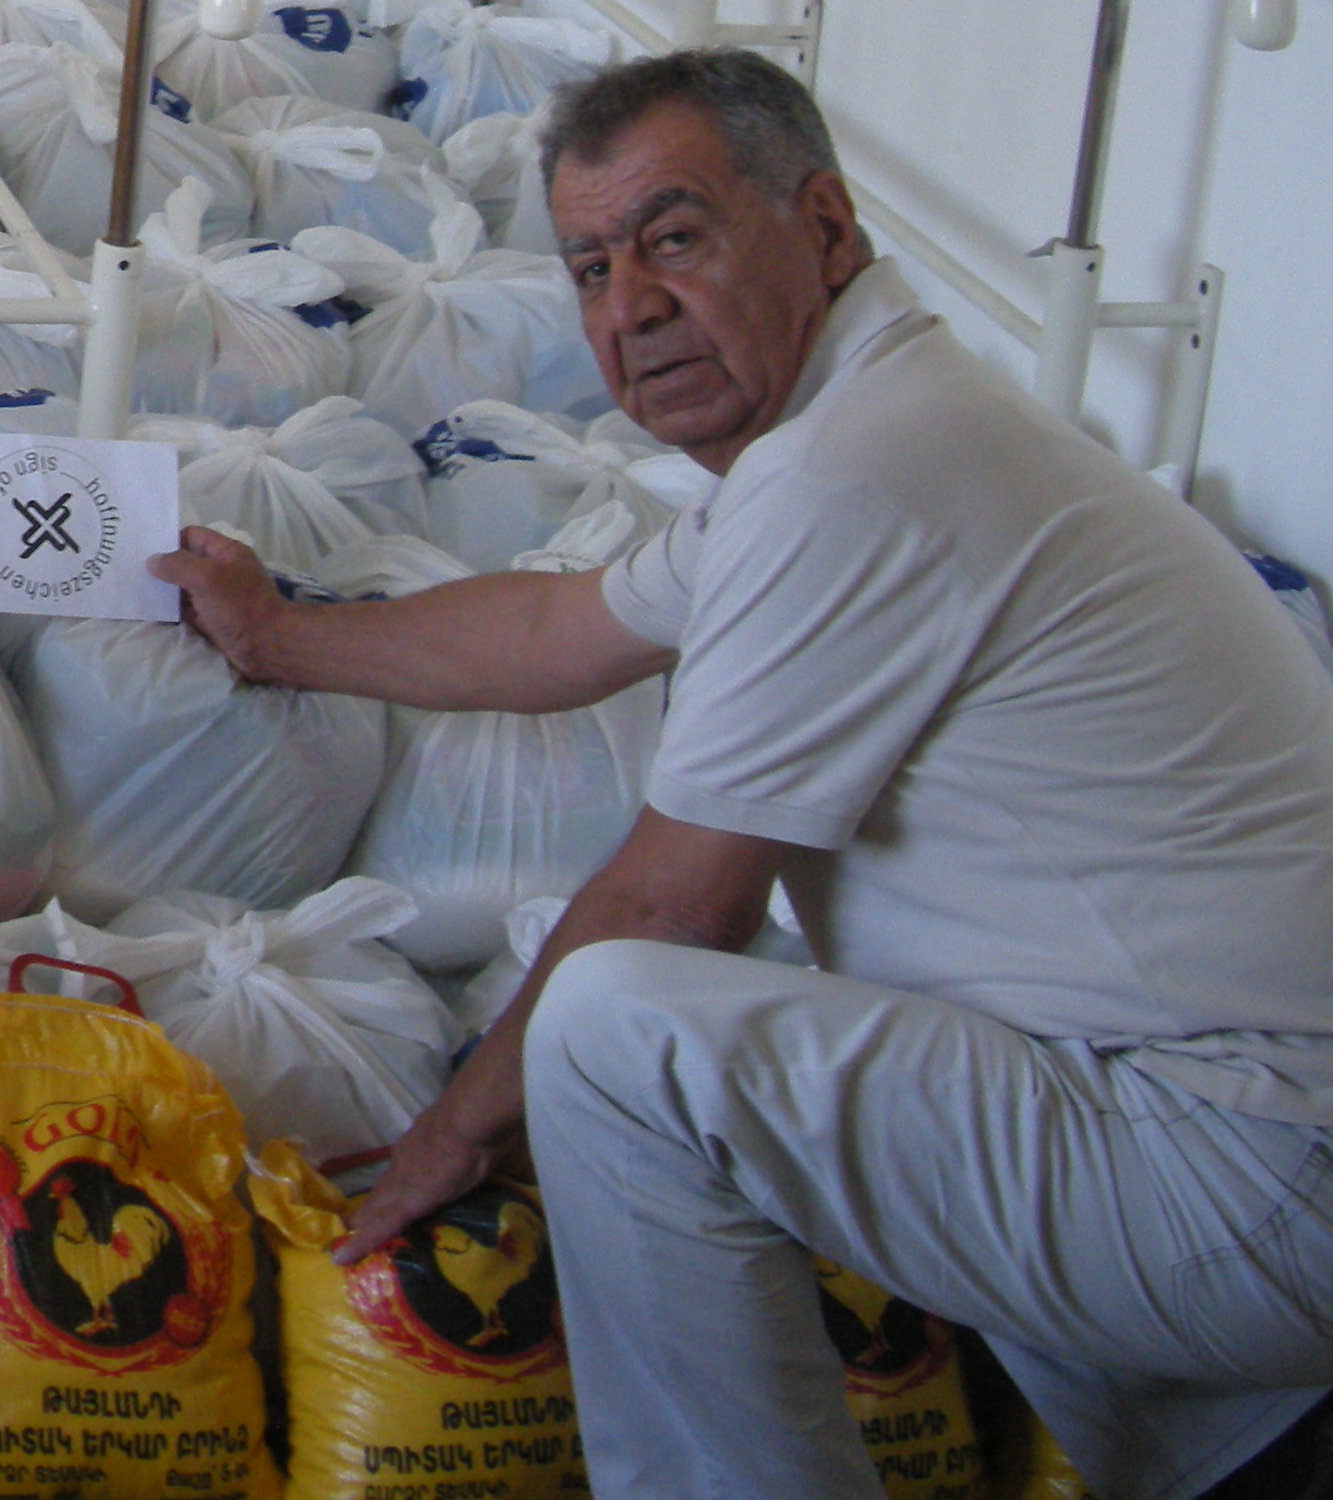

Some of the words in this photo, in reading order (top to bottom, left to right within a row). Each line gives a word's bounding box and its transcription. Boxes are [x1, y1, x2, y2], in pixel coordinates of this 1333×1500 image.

[14, 451, 58, 476] sign
[42, 1386, 182, 1419] ԹԱՅԼԱՆԴԻ
[82, 1429, 168, 1460] ԵՐԿԱՐ
[177, 1424, 249, 1459] ԲՐԻՆՁ
[364, 1444, 473, 1474] ՍՊԻՏԱԿ
[483, 1436, 564, 1470] ԵՐԿԱՐ
